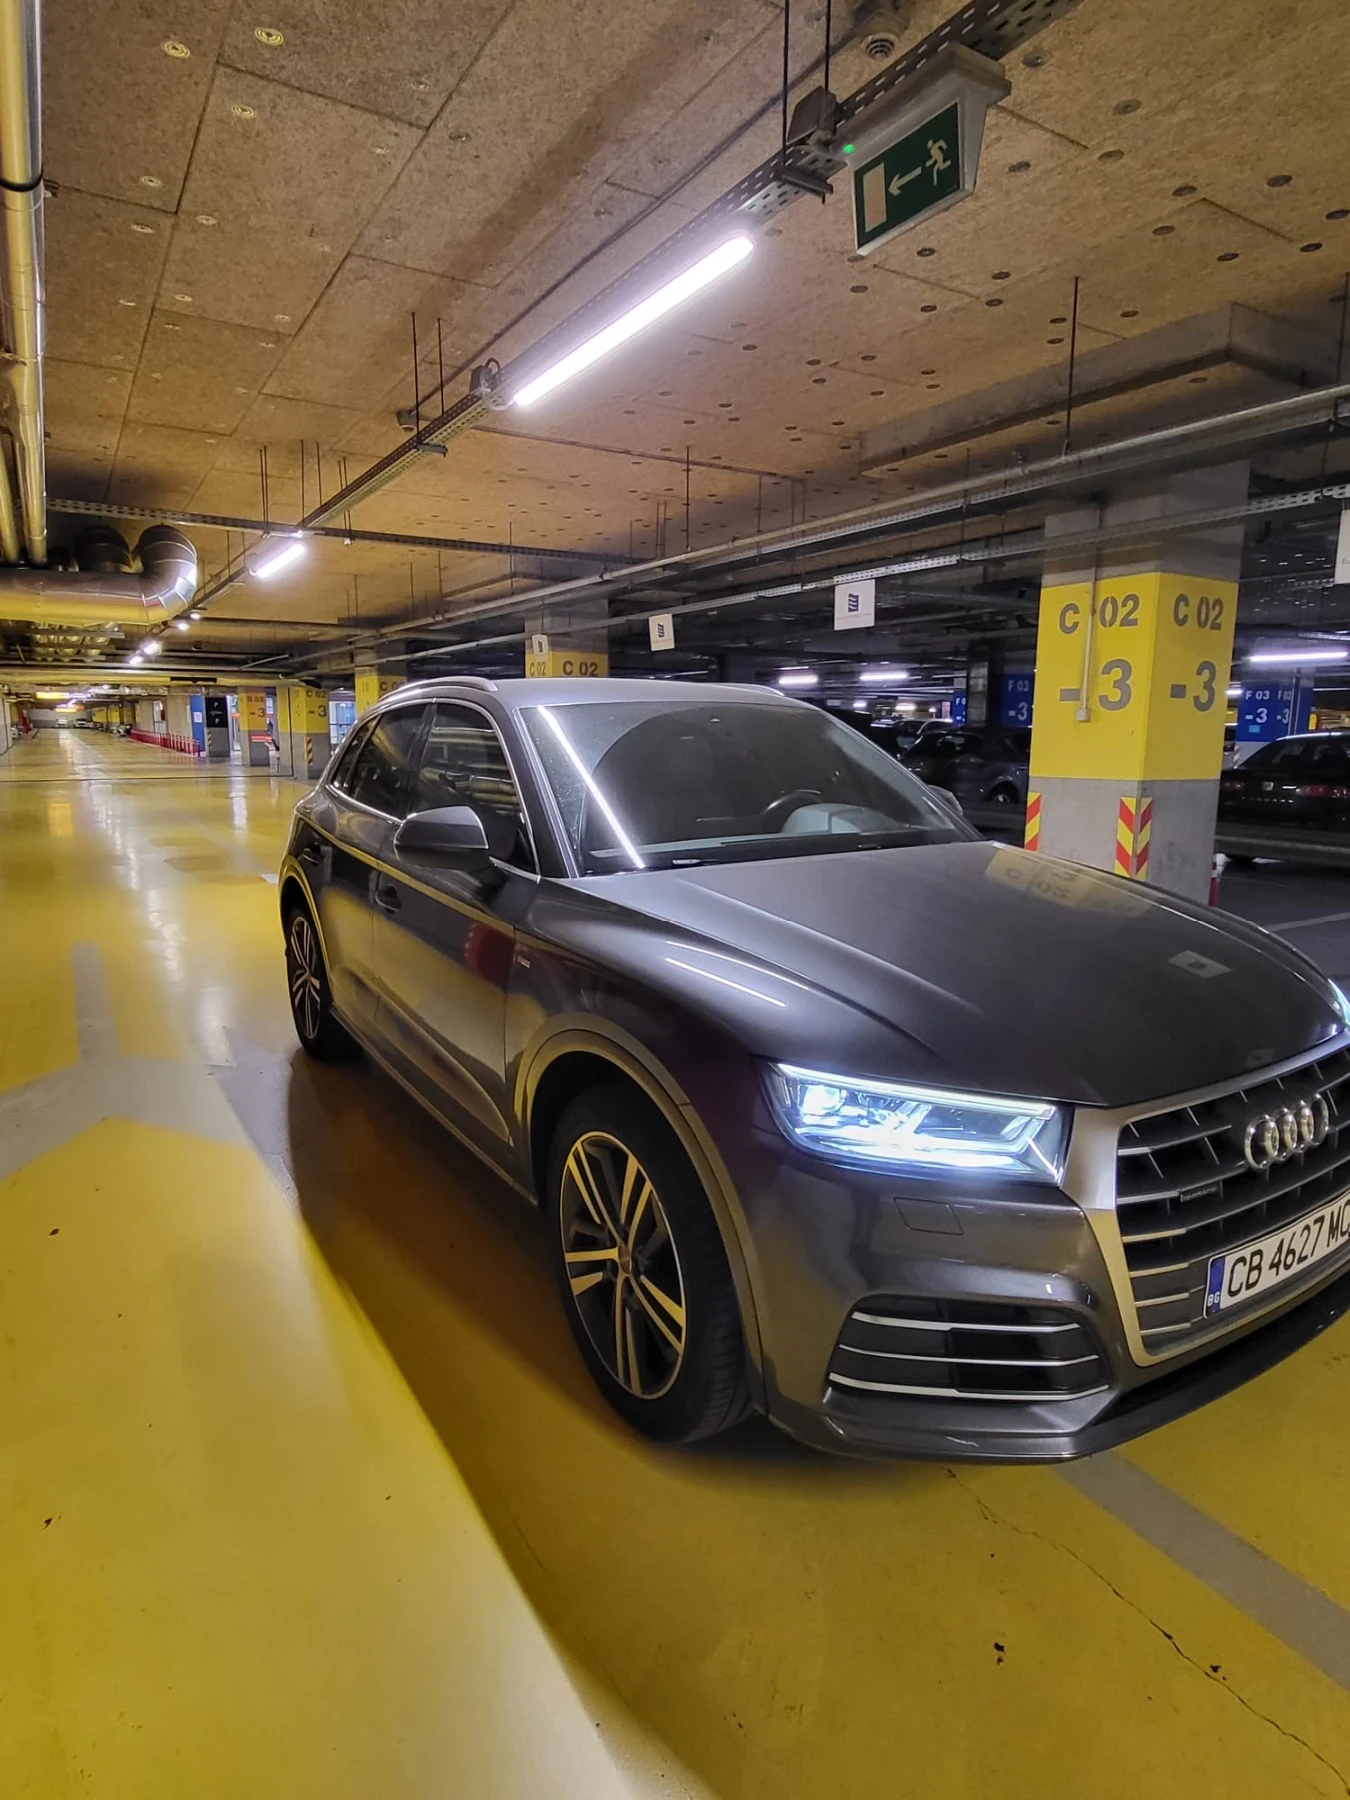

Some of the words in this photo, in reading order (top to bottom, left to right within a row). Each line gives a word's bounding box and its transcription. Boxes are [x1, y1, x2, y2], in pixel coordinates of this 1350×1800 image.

[1059, 603, 1080, 634] C
[1099, 593, 1140, 628] 02
[1173, 593, 1190, 627] C
[1196, 596, 1224, 630] 02
[562, 660, 574, 675] C
[579, 662, 599, 677] 02
[1008, 680, 1014, 691] F
[1017, 680, 1029, 691] 03
[1169, 660, 1216, 712] -3
[1245, 690, 1253, 700] F
[1255, 690, 1270, 700] 03
[1244, 707, 1268, 724] -3
[1228, 1249, 1264, 1297] CB
[1268, 1214, 1326, 1277] 4627
[1207, 1291, 1221, 1305] BG
